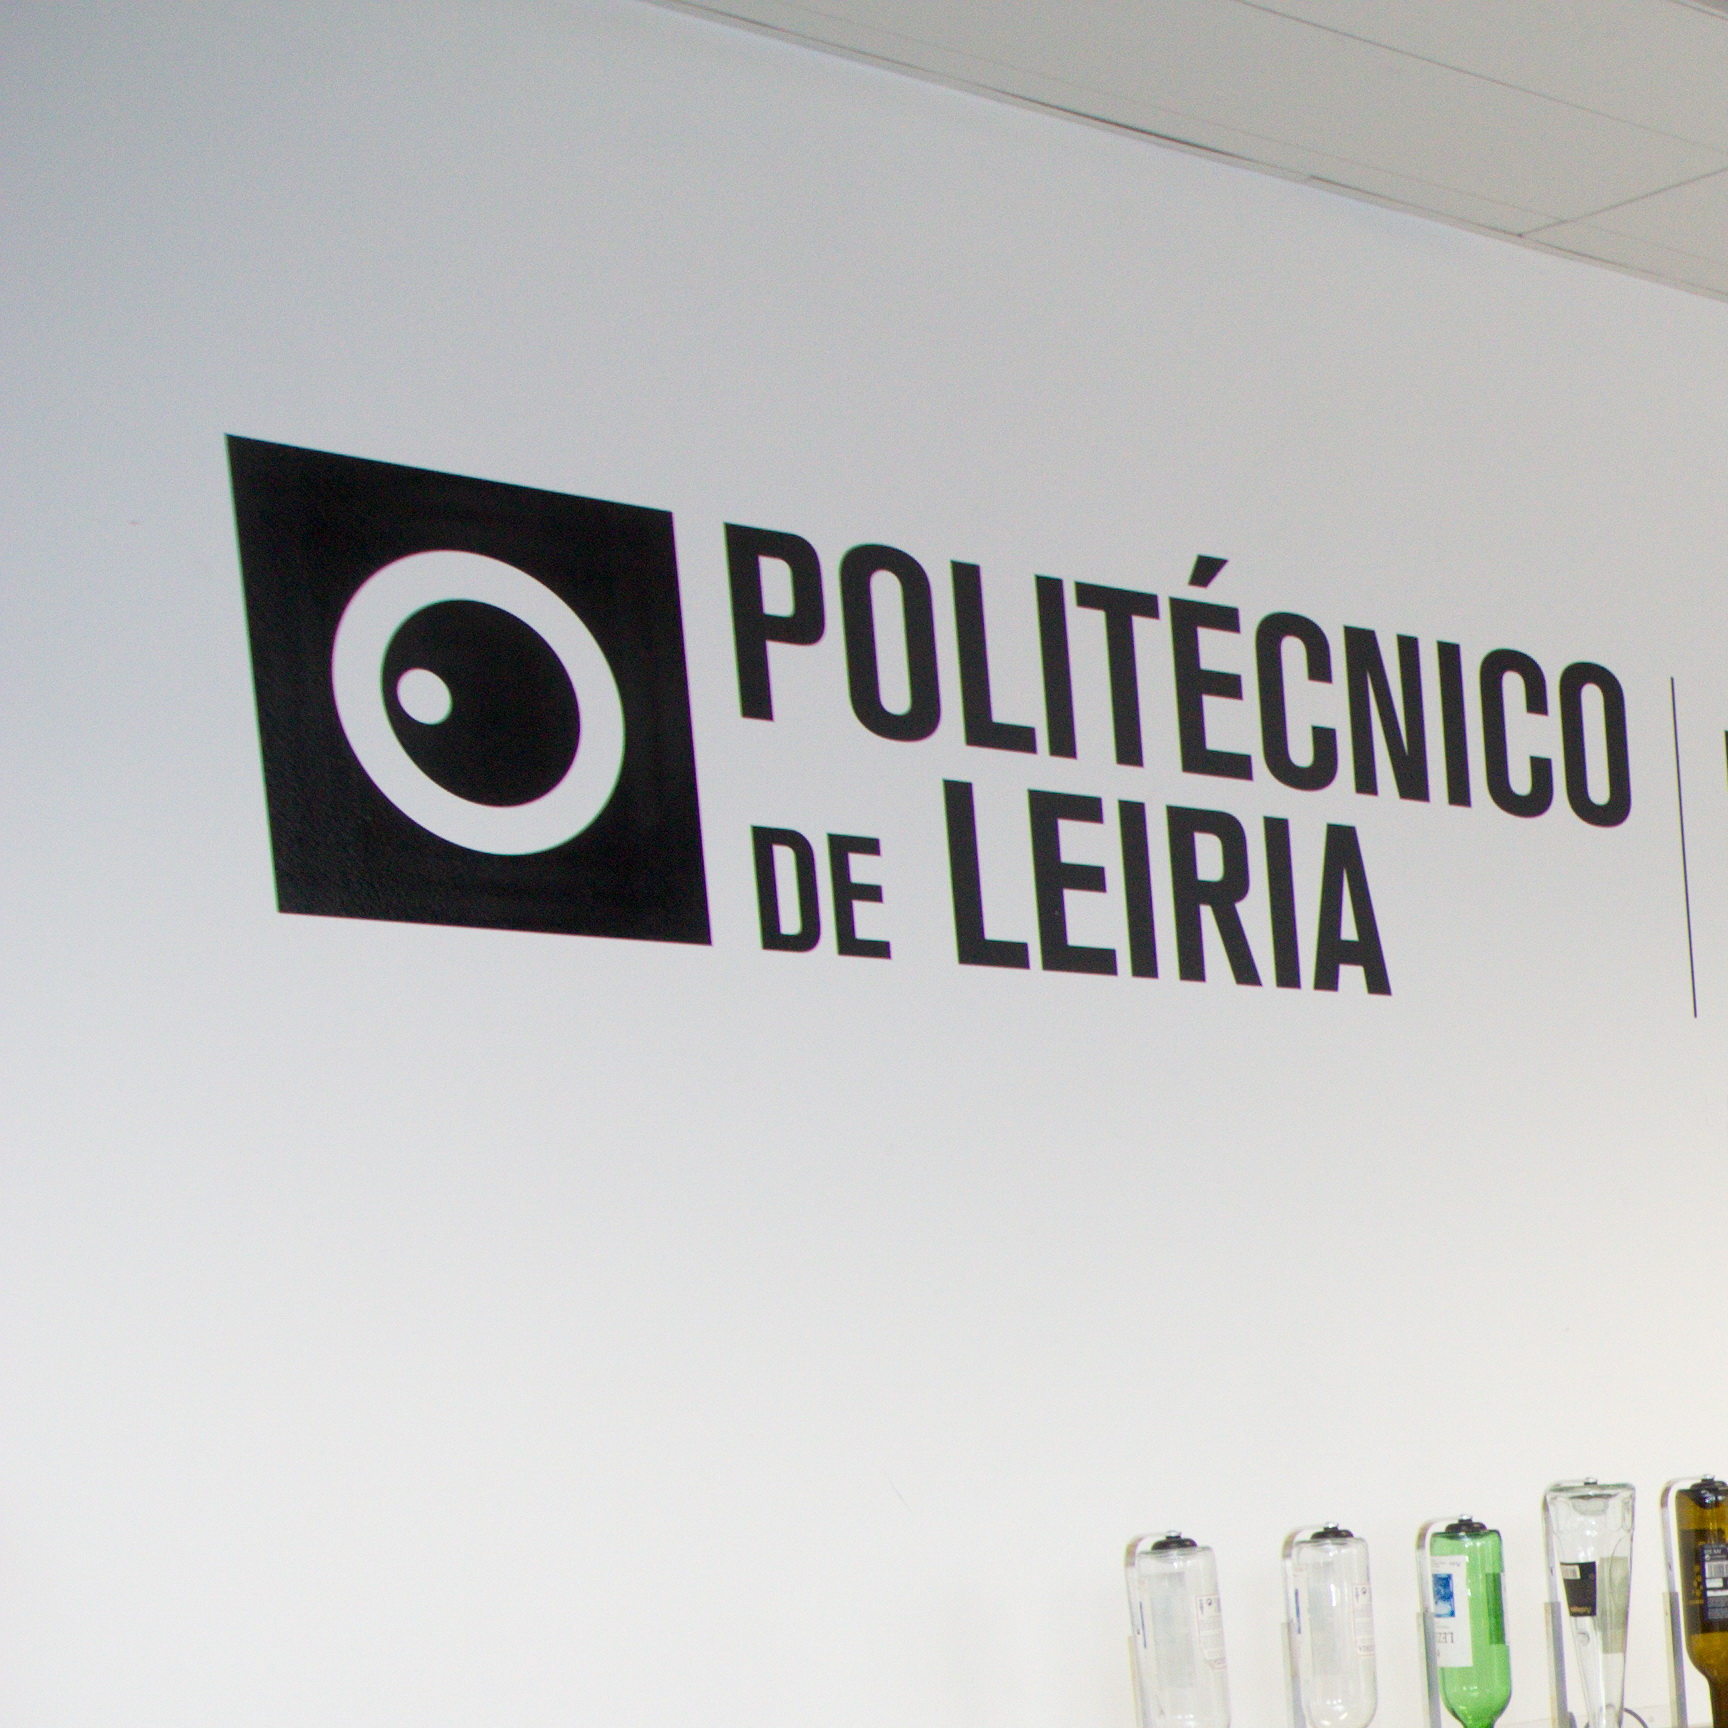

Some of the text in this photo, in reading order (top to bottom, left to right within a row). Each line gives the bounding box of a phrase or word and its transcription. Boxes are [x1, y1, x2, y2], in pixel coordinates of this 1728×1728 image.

[722, 517, 1635, 828] POLITÉCNICO
[750, 777, 1394, 997] DE LEIRIA
